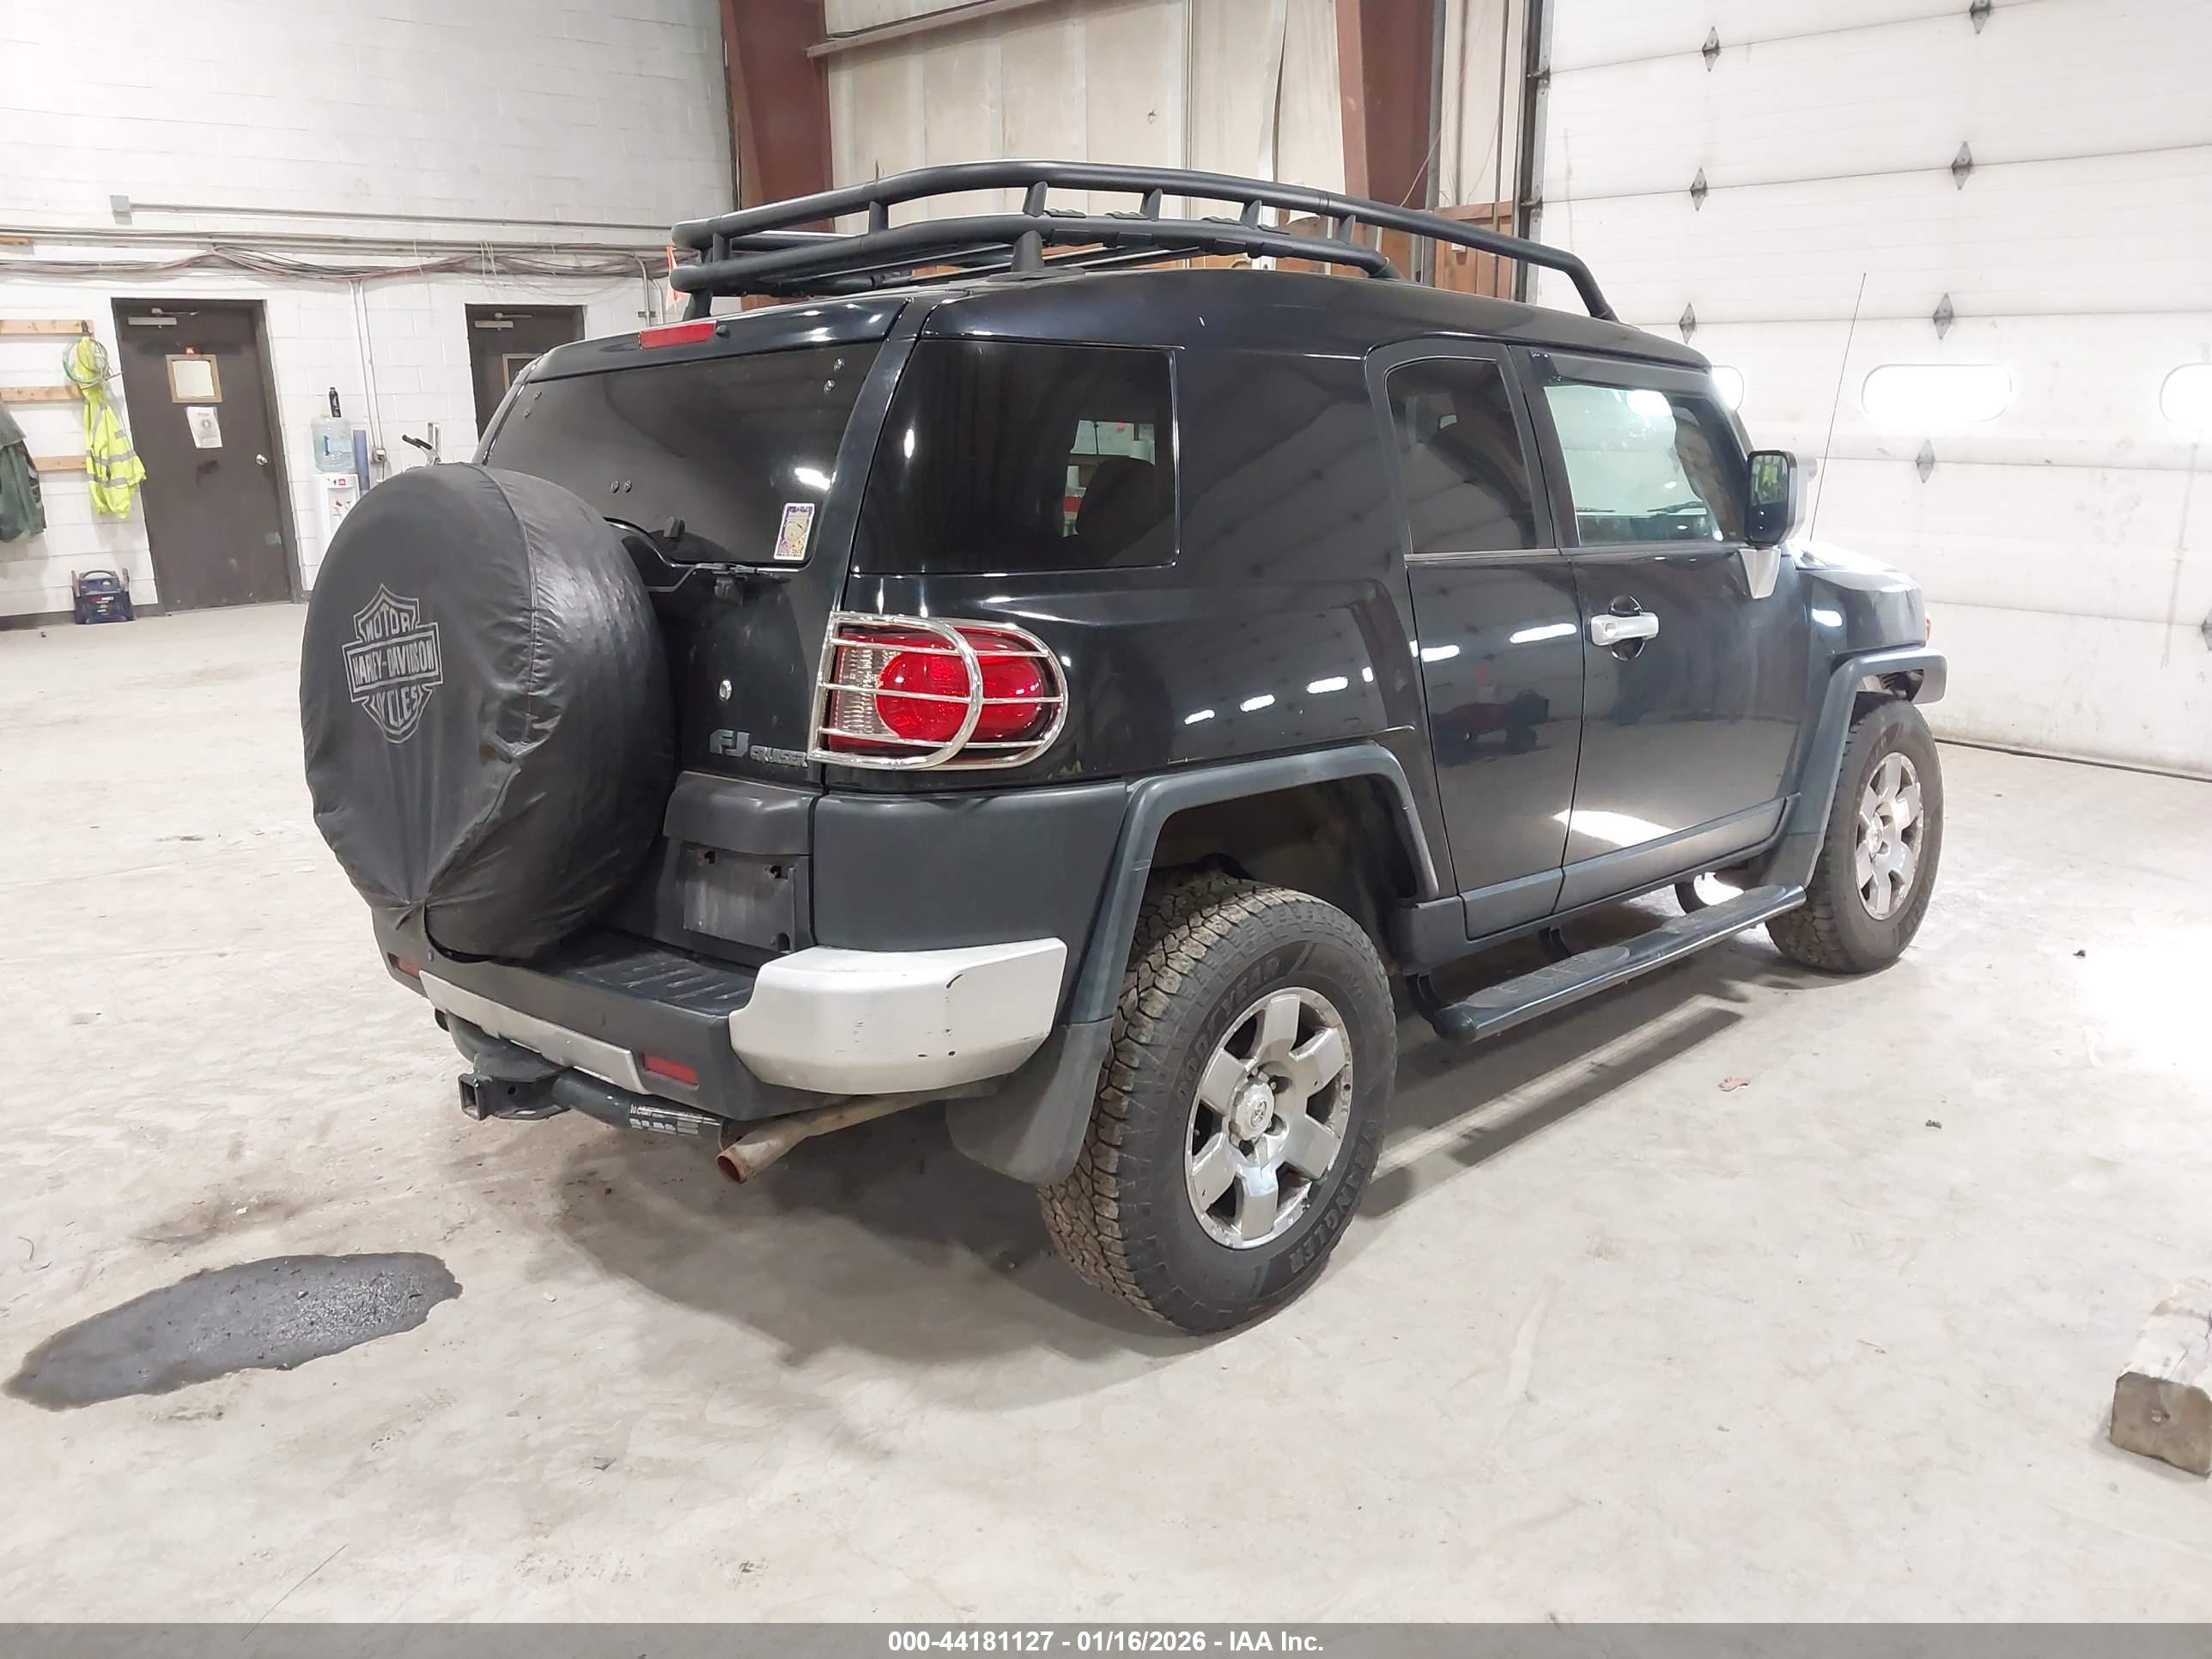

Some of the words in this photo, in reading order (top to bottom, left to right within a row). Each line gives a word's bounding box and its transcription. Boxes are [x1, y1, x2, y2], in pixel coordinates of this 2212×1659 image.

[365, 603, 411, 642] MOTOR
[351, 639, 434, 686] HARLEY-DAVIDSON
[709, 728, 750, 758] FJ
